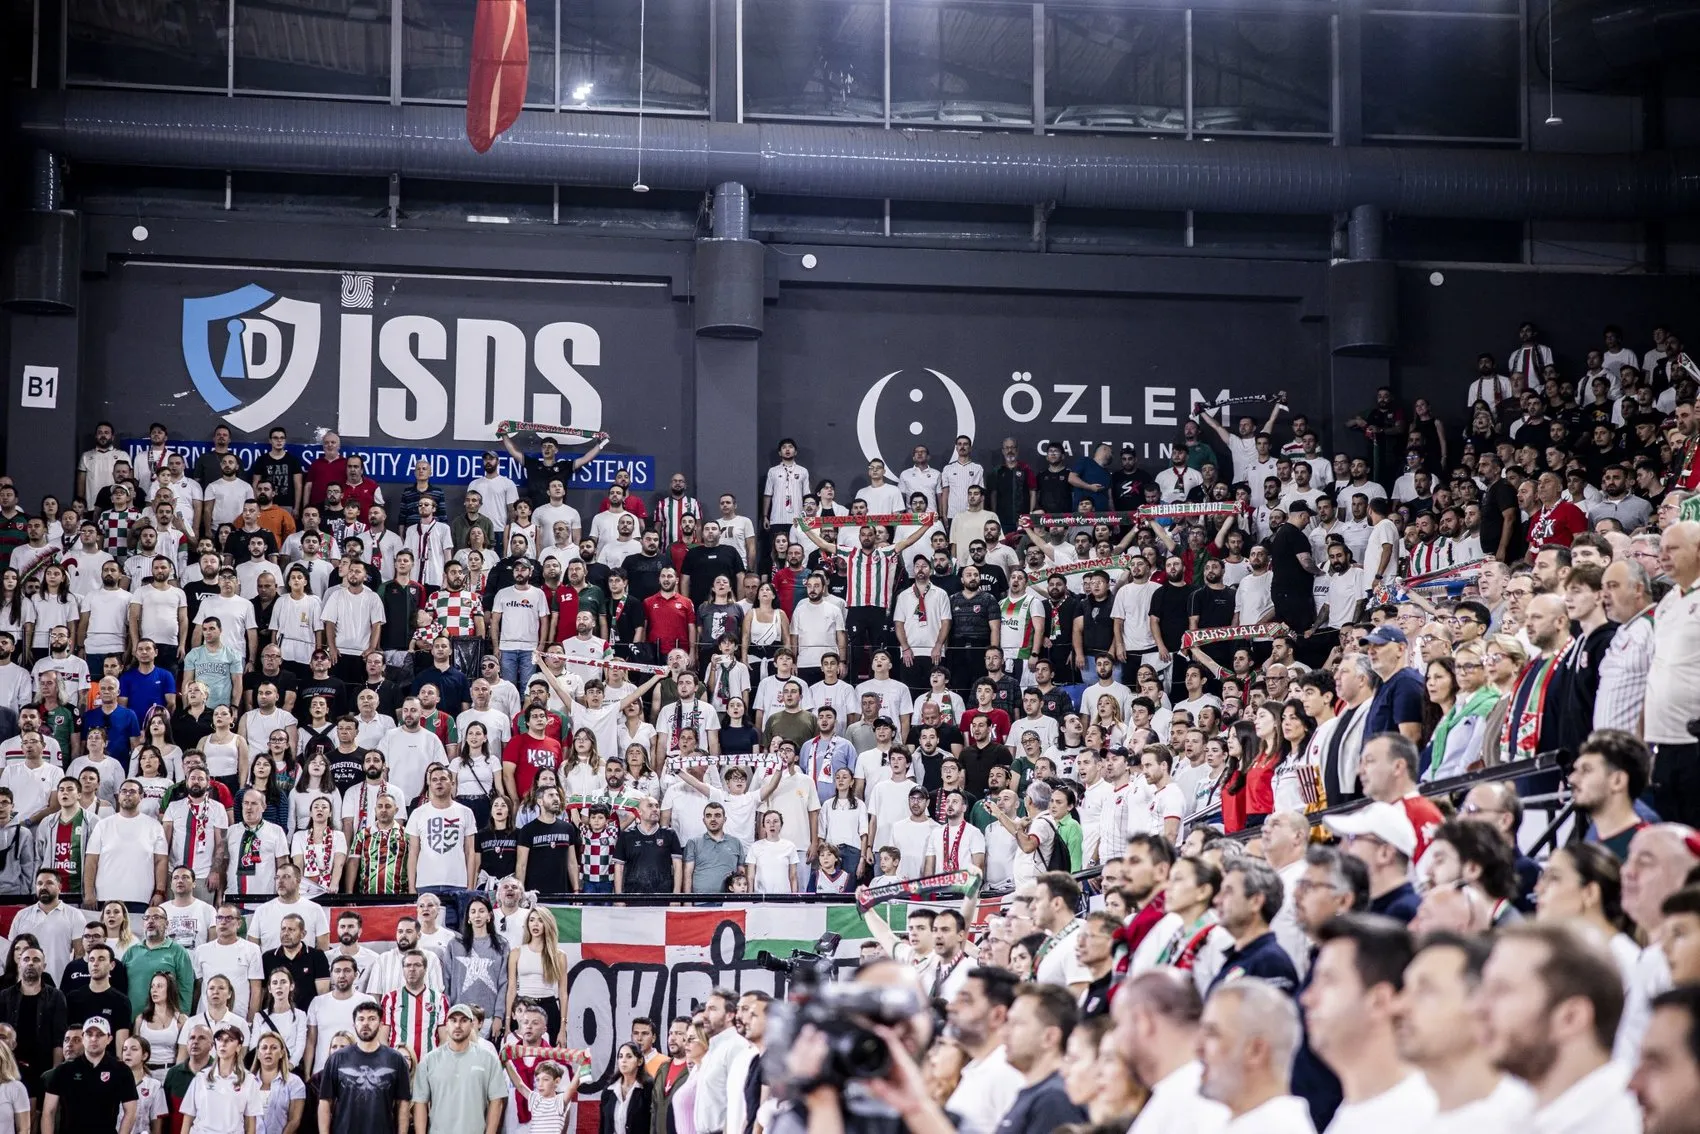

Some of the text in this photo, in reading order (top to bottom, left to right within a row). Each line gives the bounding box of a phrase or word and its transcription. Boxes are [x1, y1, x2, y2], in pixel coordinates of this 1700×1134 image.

[28, 376, 54, 398] B1
[560, 593, 573, 603] 12
[506, 600, 534, 609] ellesse
